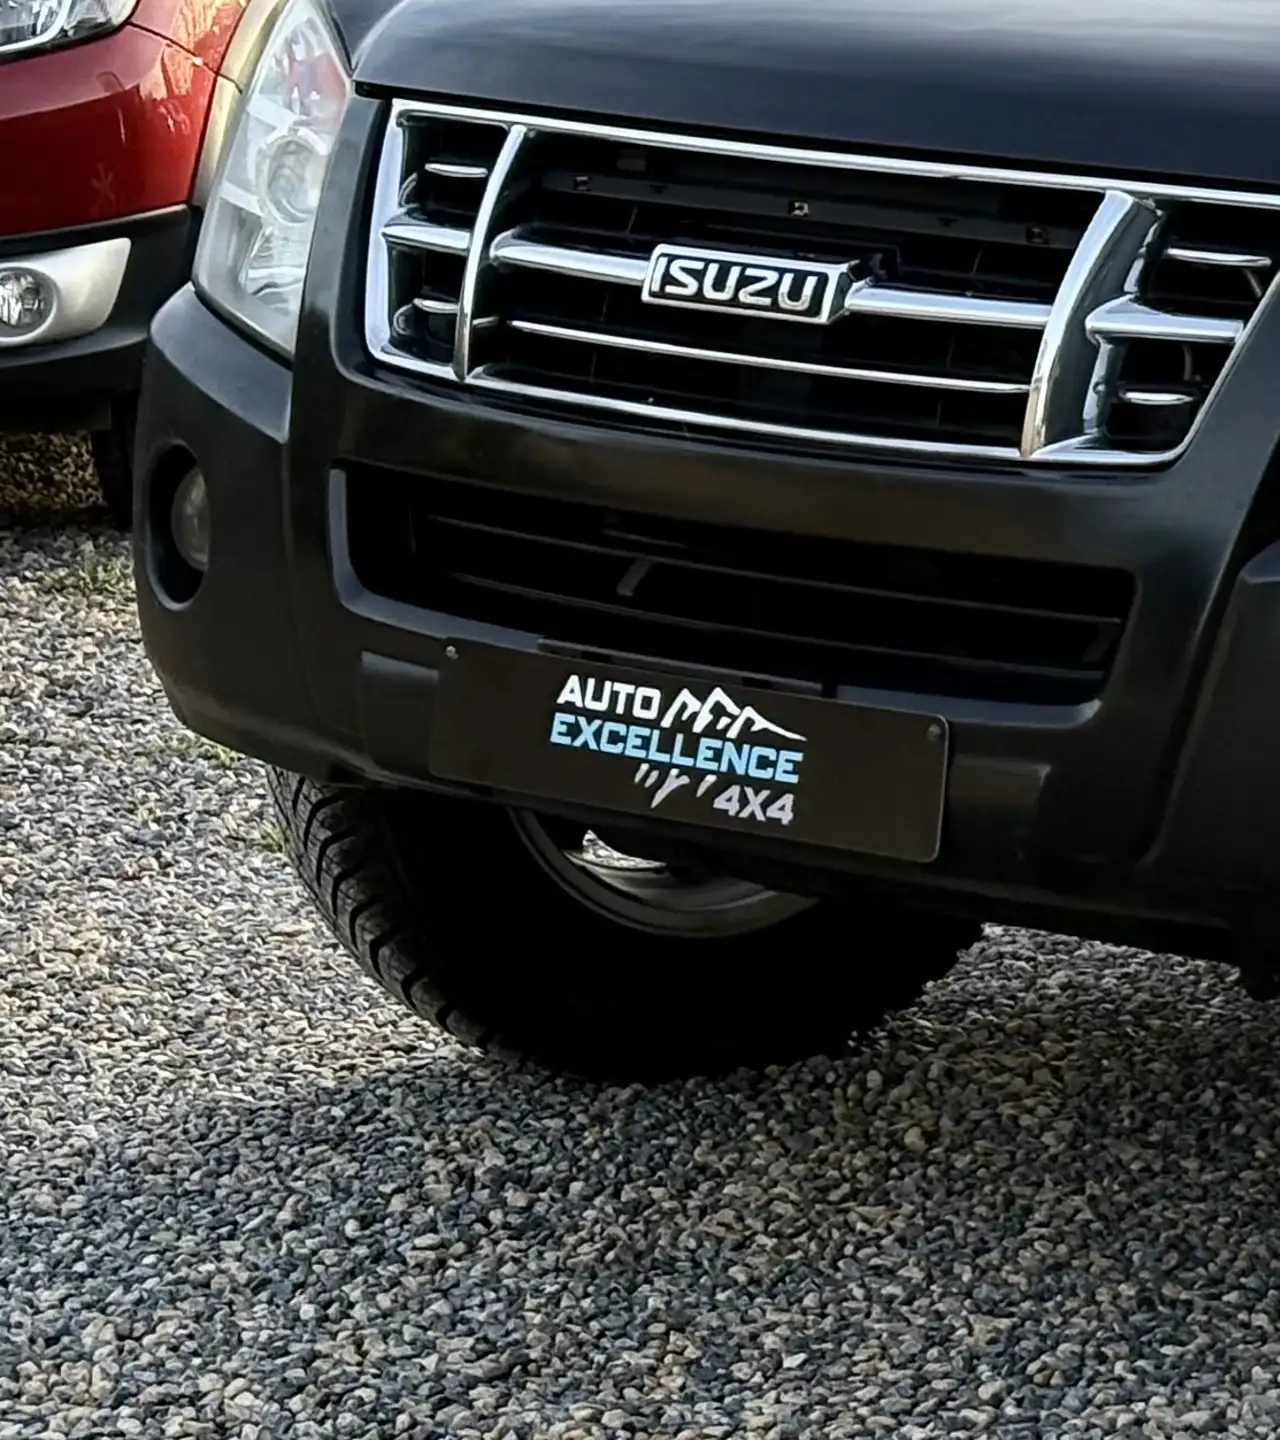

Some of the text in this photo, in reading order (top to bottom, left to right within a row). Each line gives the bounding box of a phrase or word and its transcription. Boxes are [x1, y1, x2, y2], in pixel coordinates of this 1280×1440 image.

[651, 256, 818, 310] ISUZU
[556, 674, 662, 720] AUTO
[549, 711, 804, 785] EXCELLENCE
[712, 784, 796, 826] 4X4
